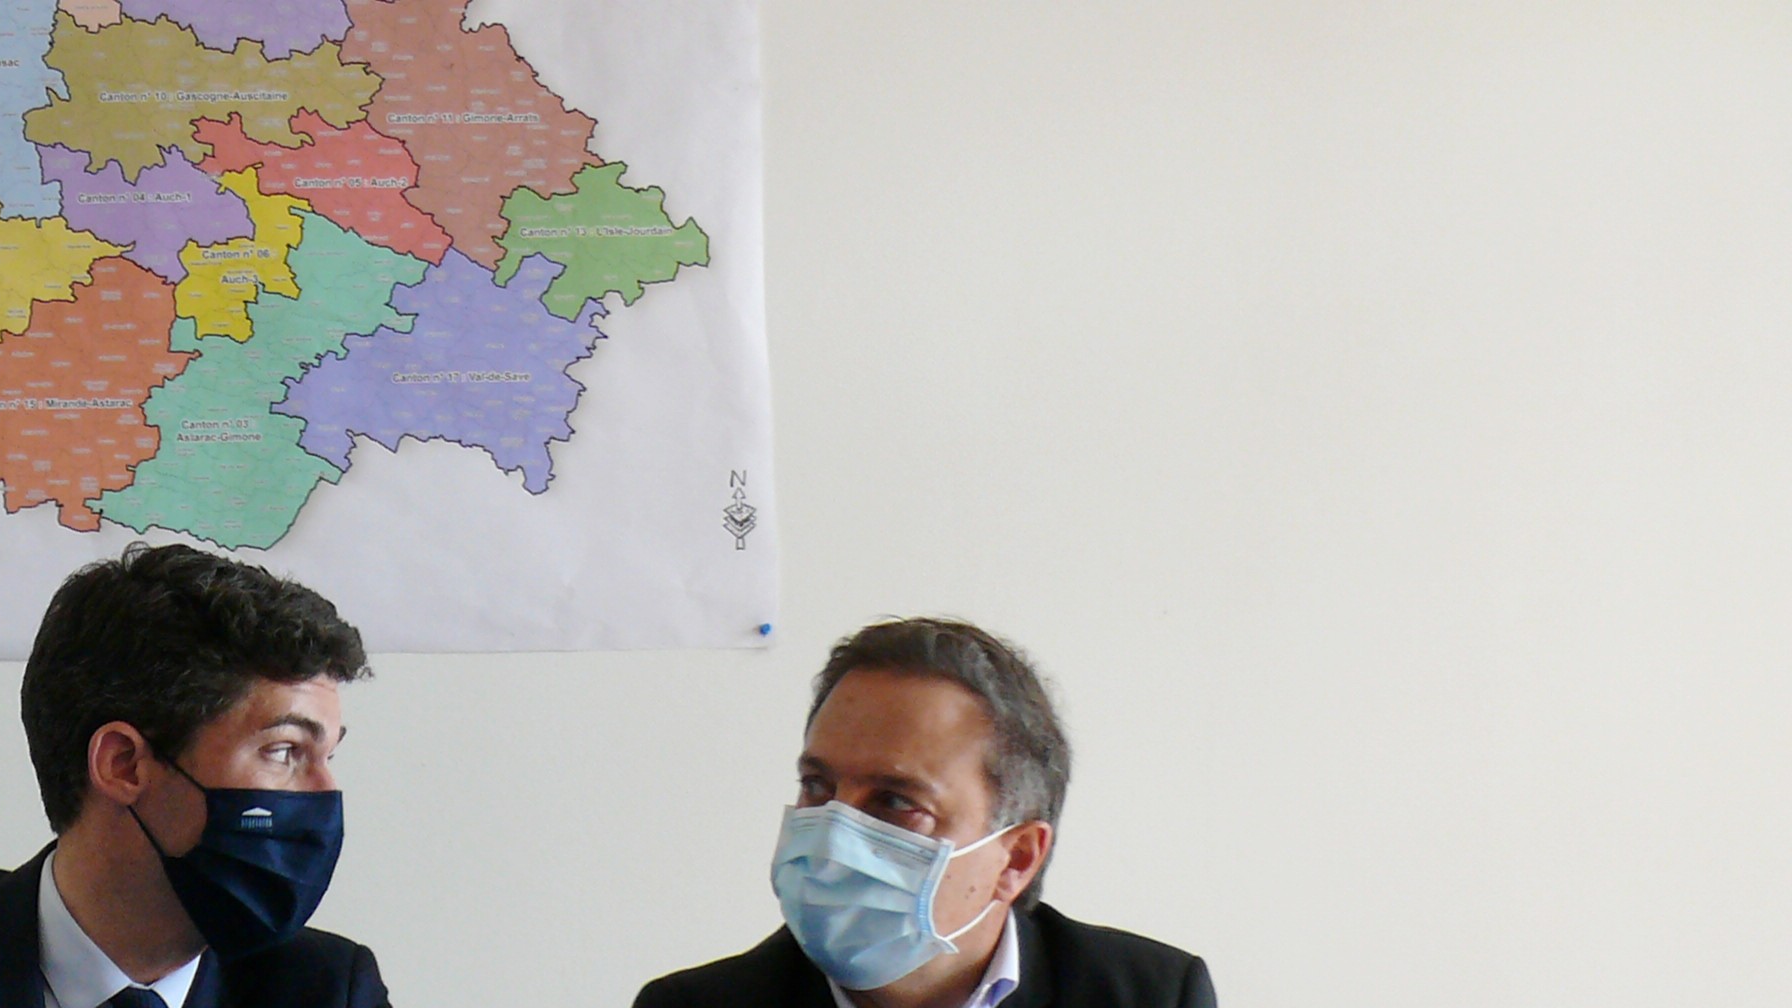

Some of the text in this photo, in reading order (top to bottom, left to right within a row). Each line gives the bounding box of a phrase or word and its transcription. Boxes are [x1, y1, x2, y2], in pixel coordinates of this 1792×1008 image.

[99, 92, 139, 101] Canton
[176, 90, 288, 102] Gascogne-Auscitaine
[387, 114, 425, 123] Canton
[463, 113, 539, 123] Gimone-Arrats
[294, 179, 331, 188] Canton
[370, 177, 407, 188] Auch-2
[78, 193, 116, 203] Canton
[519, 228, 558, 237] Canton
[202, 250, 240, 259] Canton
[257, 249, 270, 258] 06
[221, 274, 259, 284] Auch-3
[392, 373, 431, 383] Canton
[24, 400, 37, 409] 15
[45, 398, 132, 409] Mirande-Astarac
[181, 420, 220, 429] Canton
[176, 432, 262, 442] Astarac-Gimone
[729, 469, 747, 488] N
